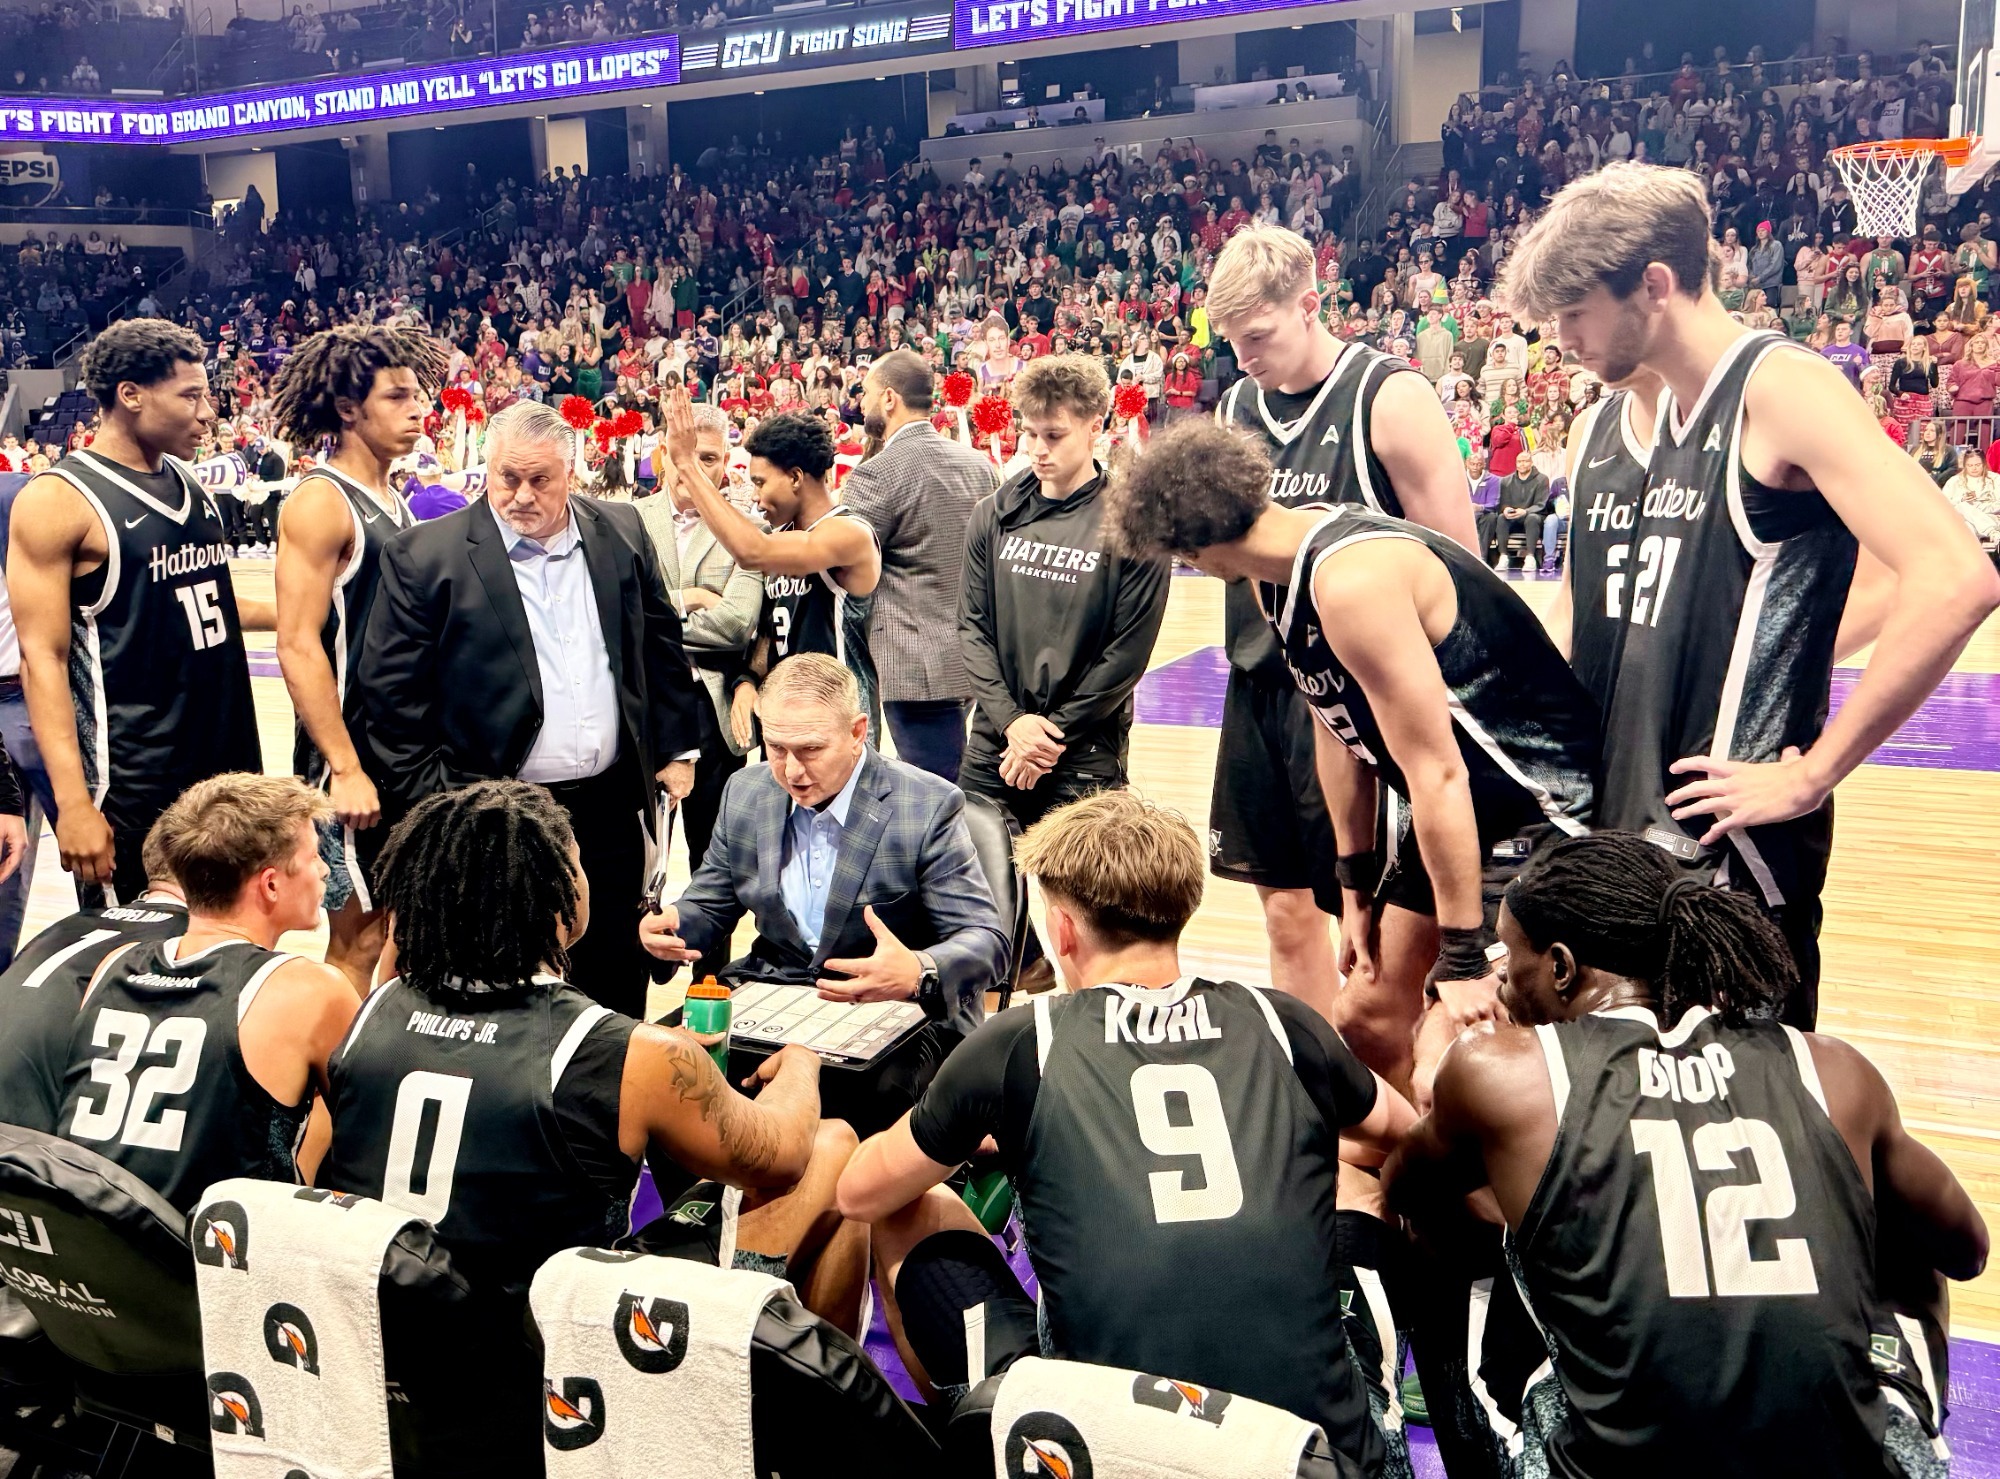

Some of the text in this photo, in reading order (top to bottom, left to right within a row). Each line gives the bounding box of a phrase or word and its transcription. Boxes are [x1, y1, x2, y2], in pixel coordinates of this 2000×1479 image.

[971, 0, 1048, 34] LET'S
[721, 21, 909, 69] GCU FIGHT SONG
[40, 110, 115, 134] FIGHT
[120, 112, 168, 135] FOR
[171, 105, 230, 133] GRAND
[233, 95, 311, 125] CANYON,
[314, 86, 375, 115] STAND
[380, 80, 421, 108] AND
[424, 74, 475, 102] YELL
[552, 59, 582, 87] GO
[1267, 468, 1331, 499] tters
[148, 542, 228, 583] Hatters
[998, 535, 1101, 573] HATTERS
[1010, 563, 1078, 584] BASKETBALL
[1629, 534, 1682, 628] 21
[174, 579, 228, 651] 15
[21, 928, 122, 988] 1
[405, 1010, 499, 1044] PHILLIPS JR.
[1105, 994, 1222, 1044] KUHL
[70, 1007, 208, 1152] 32
[1638, 1042, 1736, 1104] DIOP
[381, 1070, 473, 1224] 0
[1130, 1064, 1244, 1223] 9
[1629, 1116, 1820, 1298] 12
[0, 1261, 106, 1304] LOBAL
[54, 1297, 117, 1319] UNION
